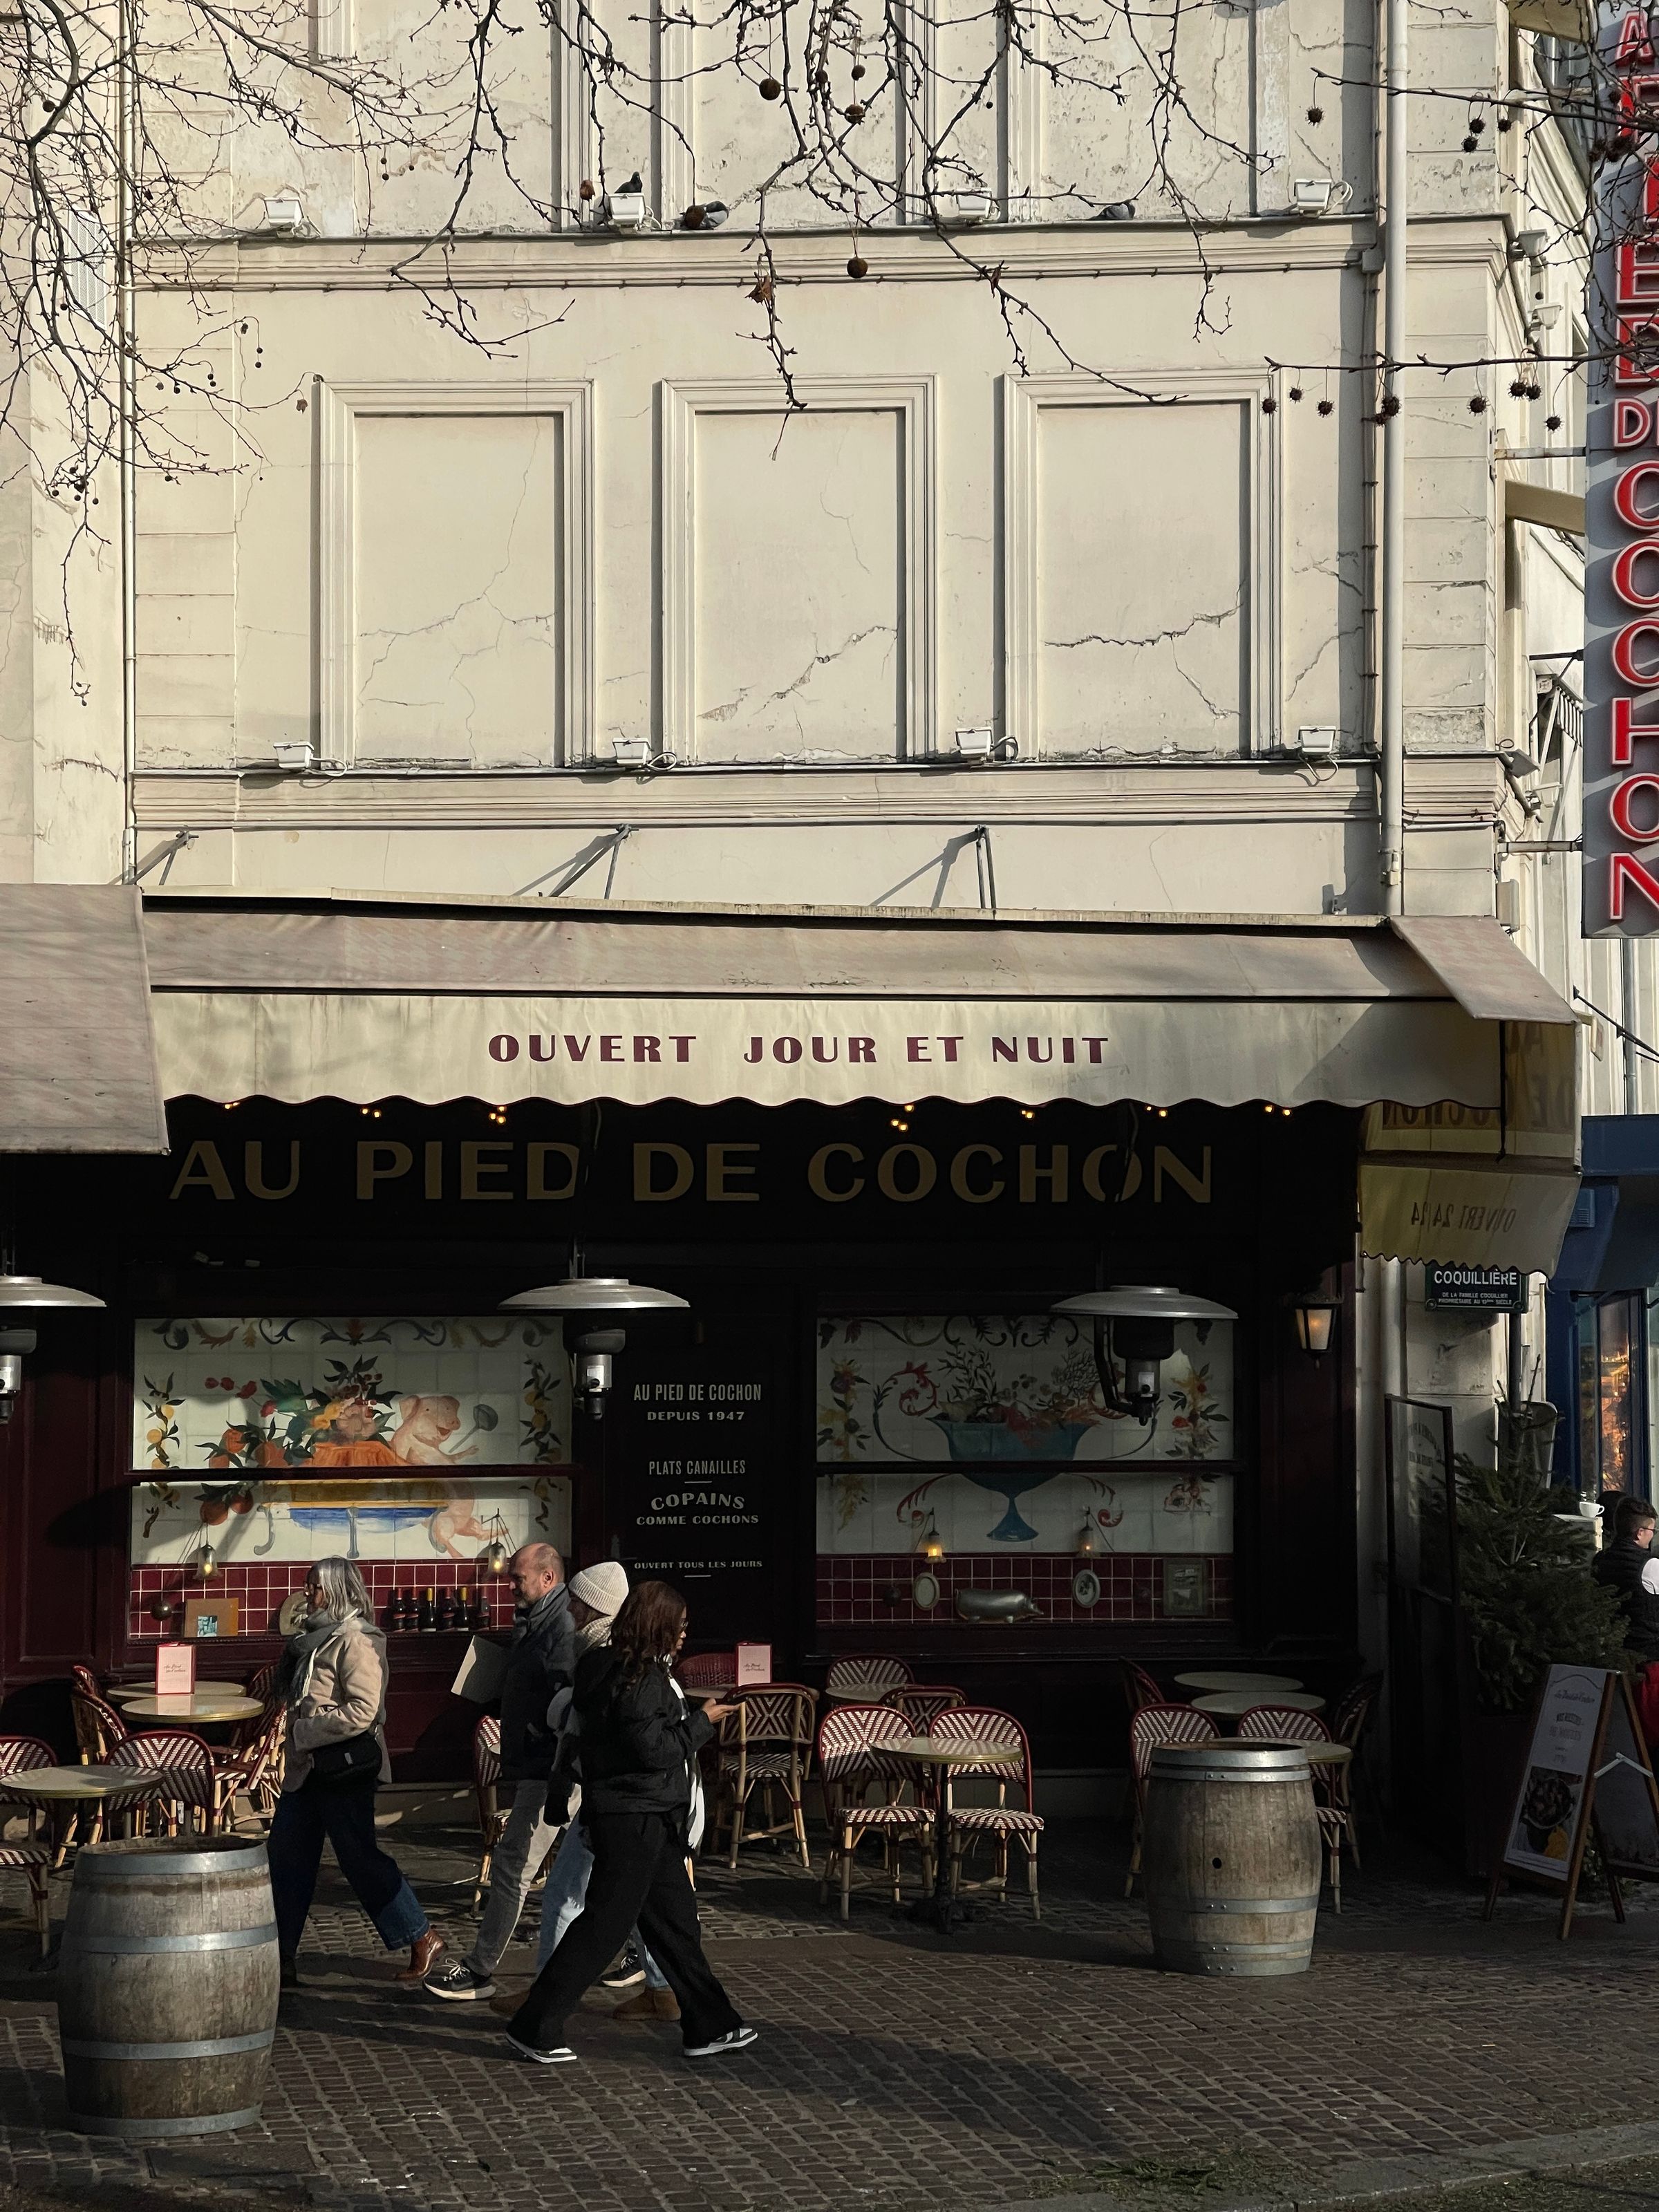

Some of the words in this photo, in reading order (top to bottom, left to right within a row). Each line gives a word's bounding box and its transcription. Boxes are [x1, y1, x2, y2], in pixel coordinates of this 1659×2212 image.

[1613, 398, 1659, 448] D
[488, 1034, 697, 1062] OUVERT
[743, 1036, 877, 1064] JOUR
[906, 1035, 964, 1062] ET
[991, 1036, 1109, 1064] NUIT
[169, 1141, 301, 1200] AU
[357, 1141, 580, 1200] PIED
[633, 1143, 760, 1201] DE
[807, 1143, 1211, 1203] COCHON
[1434, 1269, 1517, 1285] COQUILLIÈRE
[633, 1384, 650, 1401] AU
[655, 1384, 684, 1401] PIED
[688, 1384, 704, 1401] DE
[709, 1384, 762, 1401] COCHON
[647, 1411, 700, 1421] DEPUIS
[707, 1411, 745, 1421] 1947
[648, 1460, 682, 1475] PLATS
[686, 1459, 746, 1475] CANAILLES
[650, 1492, 745, 1510] COPAINS
[636, 1515, 686, 1526] COMME
[692, 1515, 759, 1525] COCHONS
